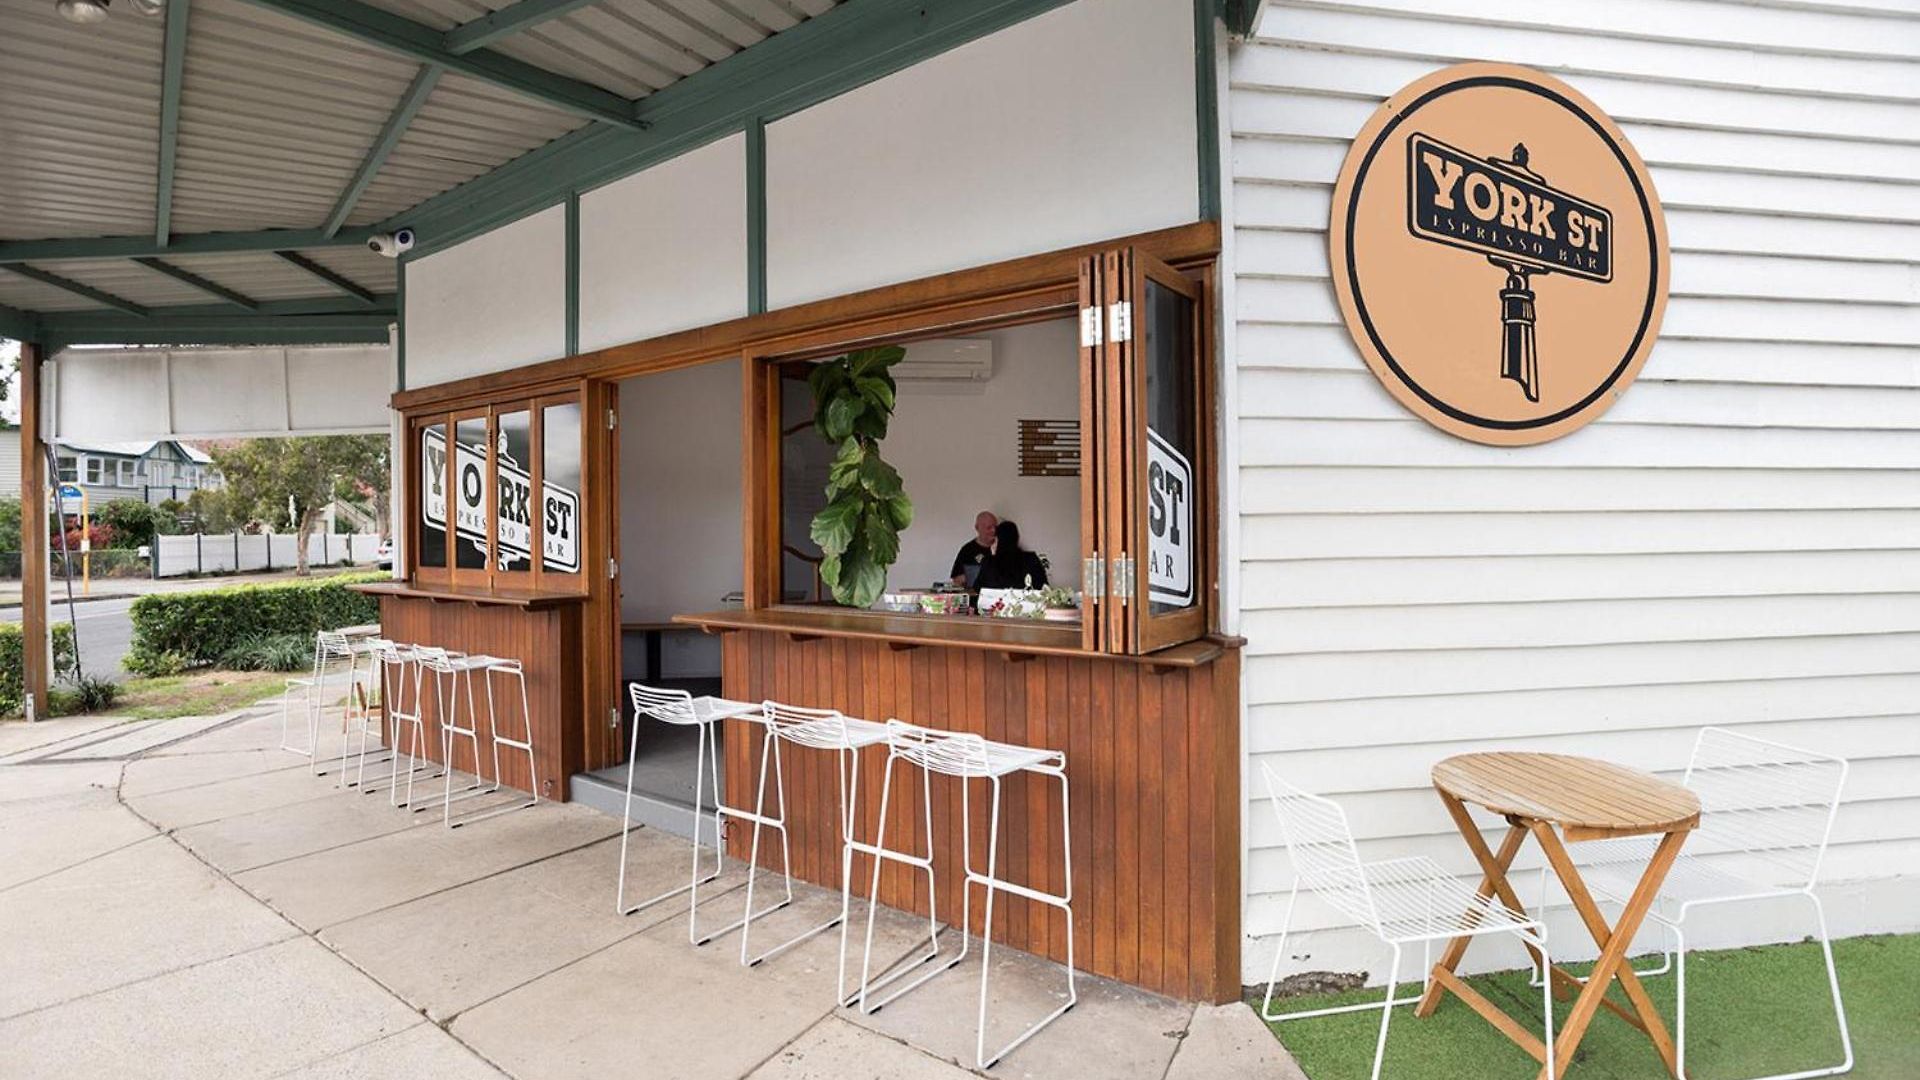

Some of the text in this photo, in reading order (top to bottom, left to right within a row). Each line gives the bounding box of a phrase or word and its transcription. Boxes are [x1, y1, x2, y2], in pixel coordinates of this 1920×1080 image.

[1422, 151, 1603, 252] YORK ST
[1433, 214, 1597, 269] ESPRESSO BAR
[428, 445, 571, 540] YORK ST
[1149, 460, 1183, 546] ST
[1150, 549, 1174, 578] AR
